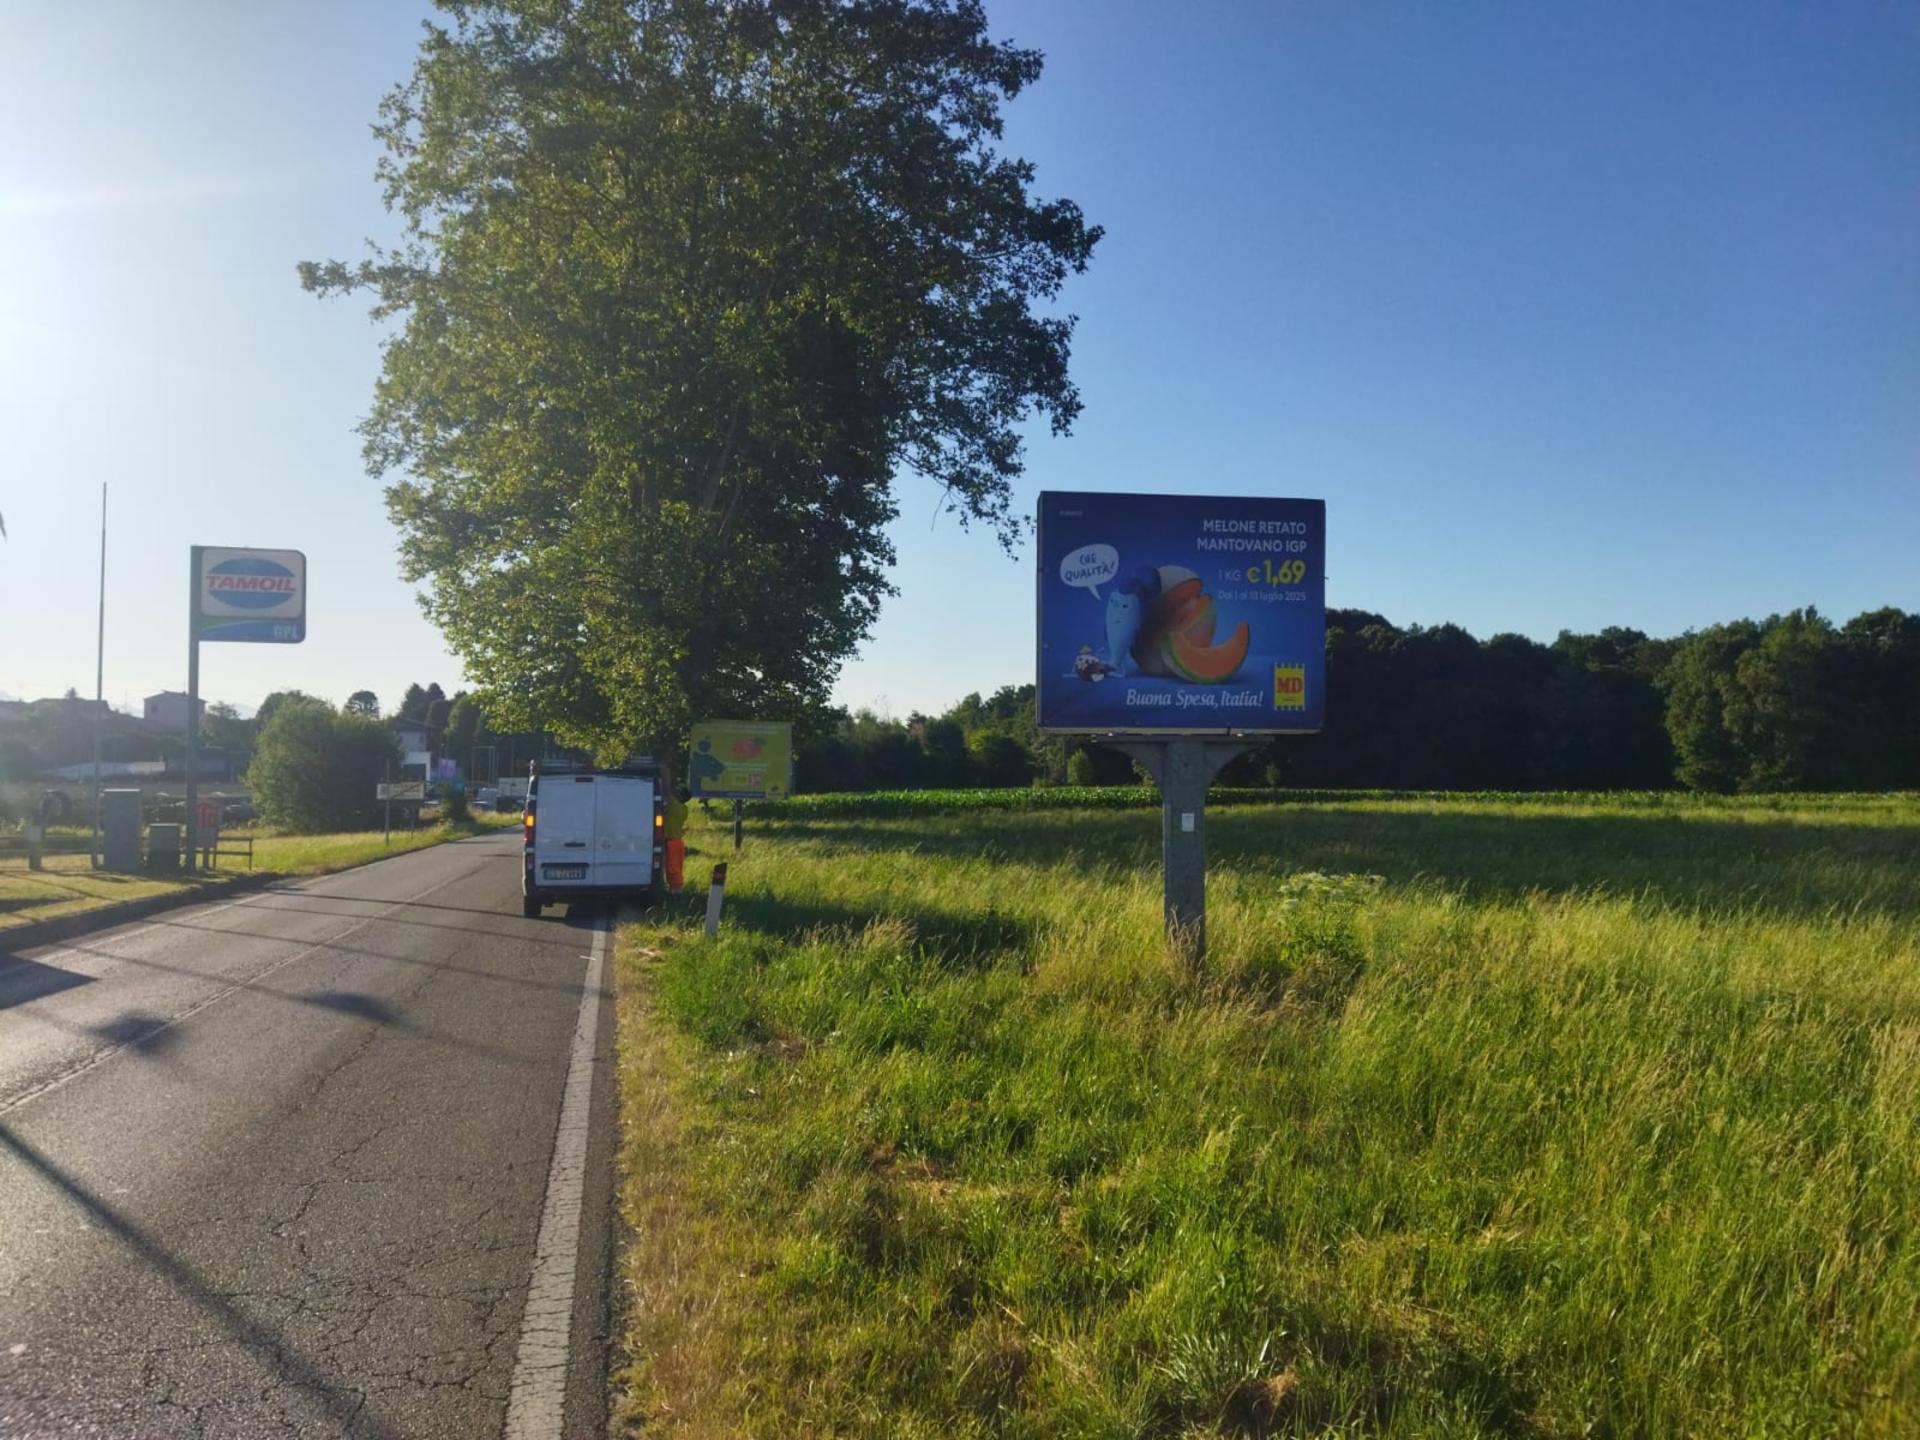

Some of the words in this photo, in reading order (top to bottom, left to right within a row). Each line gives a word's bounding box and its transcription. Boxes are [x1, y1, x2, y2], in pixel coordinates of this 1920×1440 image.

[1203, 520, 1256, 533] MELONE
[1259, 521, 1306, 534] RETATO
[1197, 537, 1283, 552] MANTOVANO
[1286, 540, 1307, 552] IGP
[1064, 561, 1115, 582] QUALITÀ!
[1225, 569, 1241, 581] KG
[206, 576, 296, 591] TAMOIL
[1218, 590, 1233, 600] Dal
[1285, 592, 1306, 601] 2025
[273, 624, 299, 639] GPL
[1277, 677, 1303, 693] MD
[1126, 688, 1171, 706] Buona
[1175, 690, 1219, 709] Spesa,
[1221, 690, 1263, 707] Italia!
